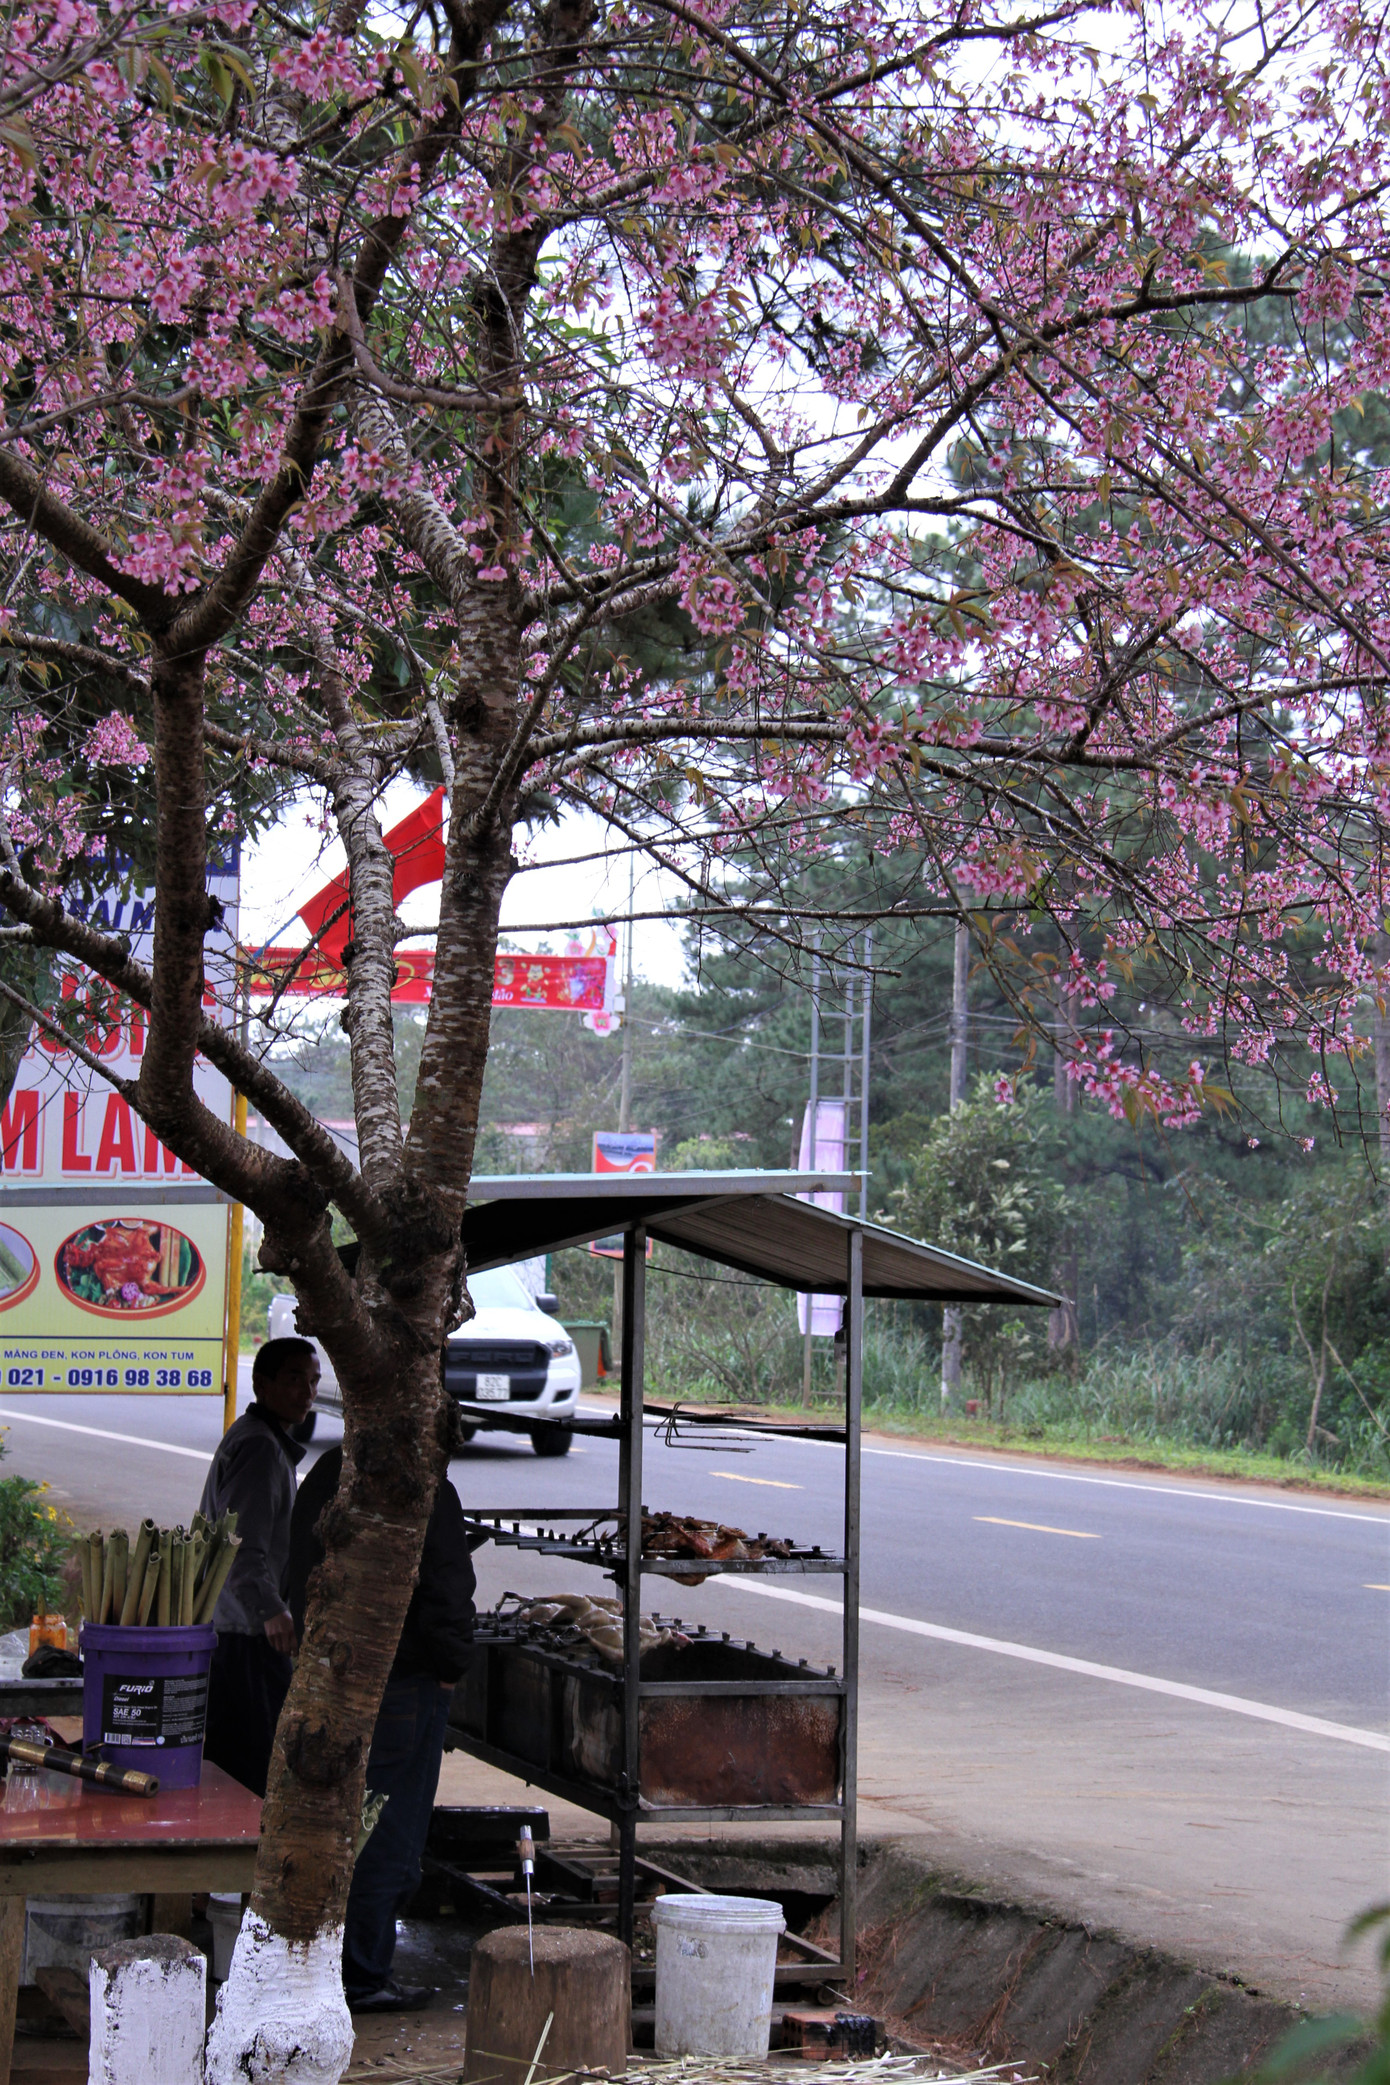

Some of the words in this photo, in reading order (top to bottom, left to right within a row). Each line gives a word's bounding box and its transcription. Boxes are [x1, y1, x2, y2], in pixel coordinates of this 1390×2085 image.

[71, 1351, 95, 1359] KON
[143, 1351, 168, 1360] KON
[171, 1352, 194, 1360] TUM
[8, 1368, 44, 1386] 021
[68, 1369, 118, 1387] 0916
[125, 1369, 150, 1387] 98
[156, 1369, 181, 1387] 38
[187, 1370, 212, 1388] 68
[113, 1708, 129, 1716] SAE
[131, 1709, 142, 1717] 50
